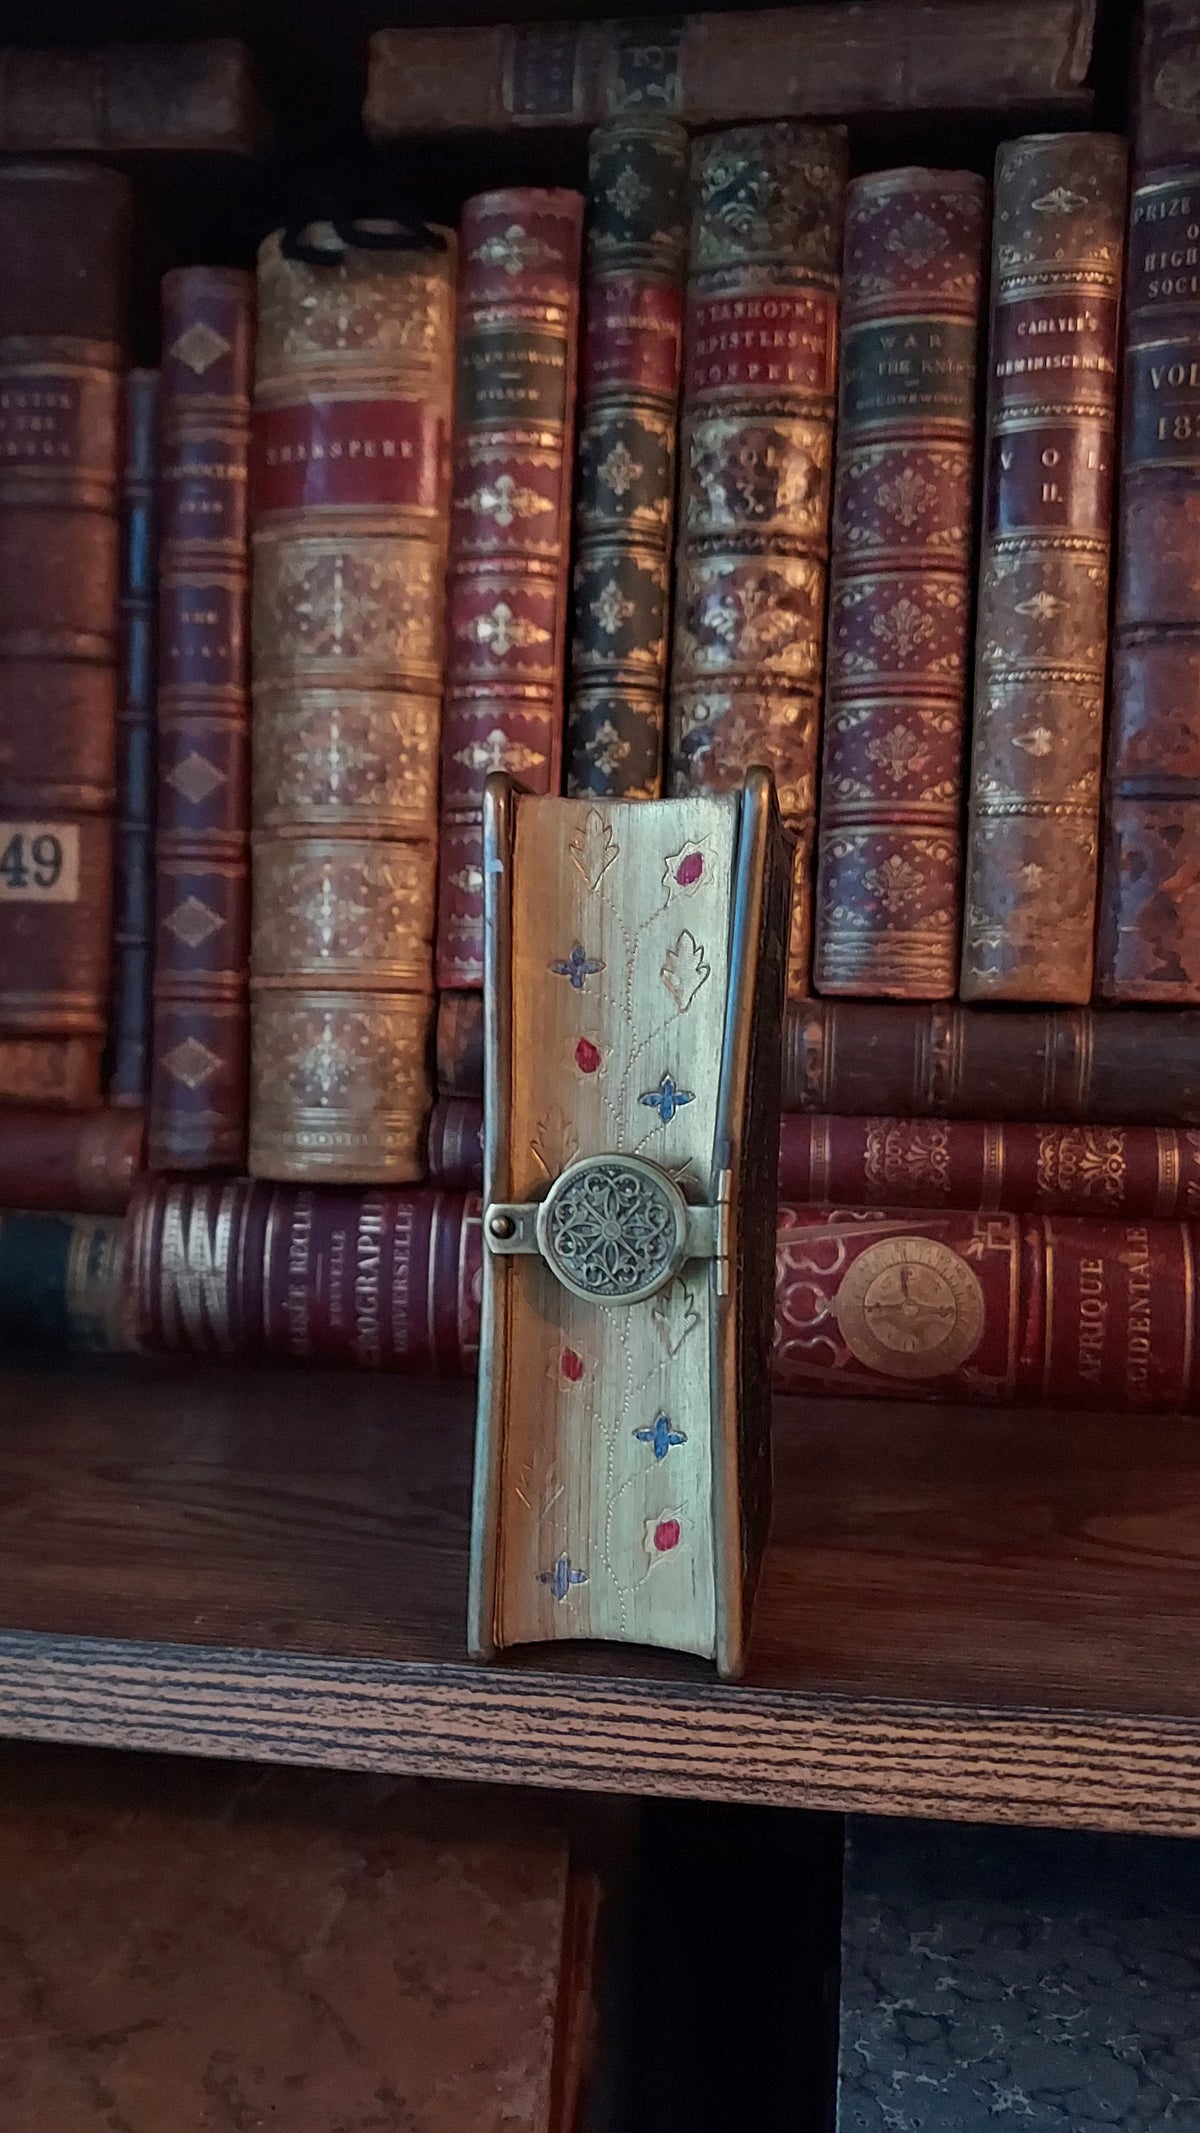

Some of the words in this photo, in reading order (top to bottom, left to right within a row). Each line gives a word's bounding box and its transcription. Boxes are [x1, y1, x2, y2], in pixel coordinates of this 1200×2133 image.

[1134, 196, 1192, 223] PRIZE
[1144, 247, 1198, 273] HIGH
[879, 333, 942, 349] WAR
[0, 832, 62, 889] 49
[1079, 1258, 1109, 1384] AFRIQUE
